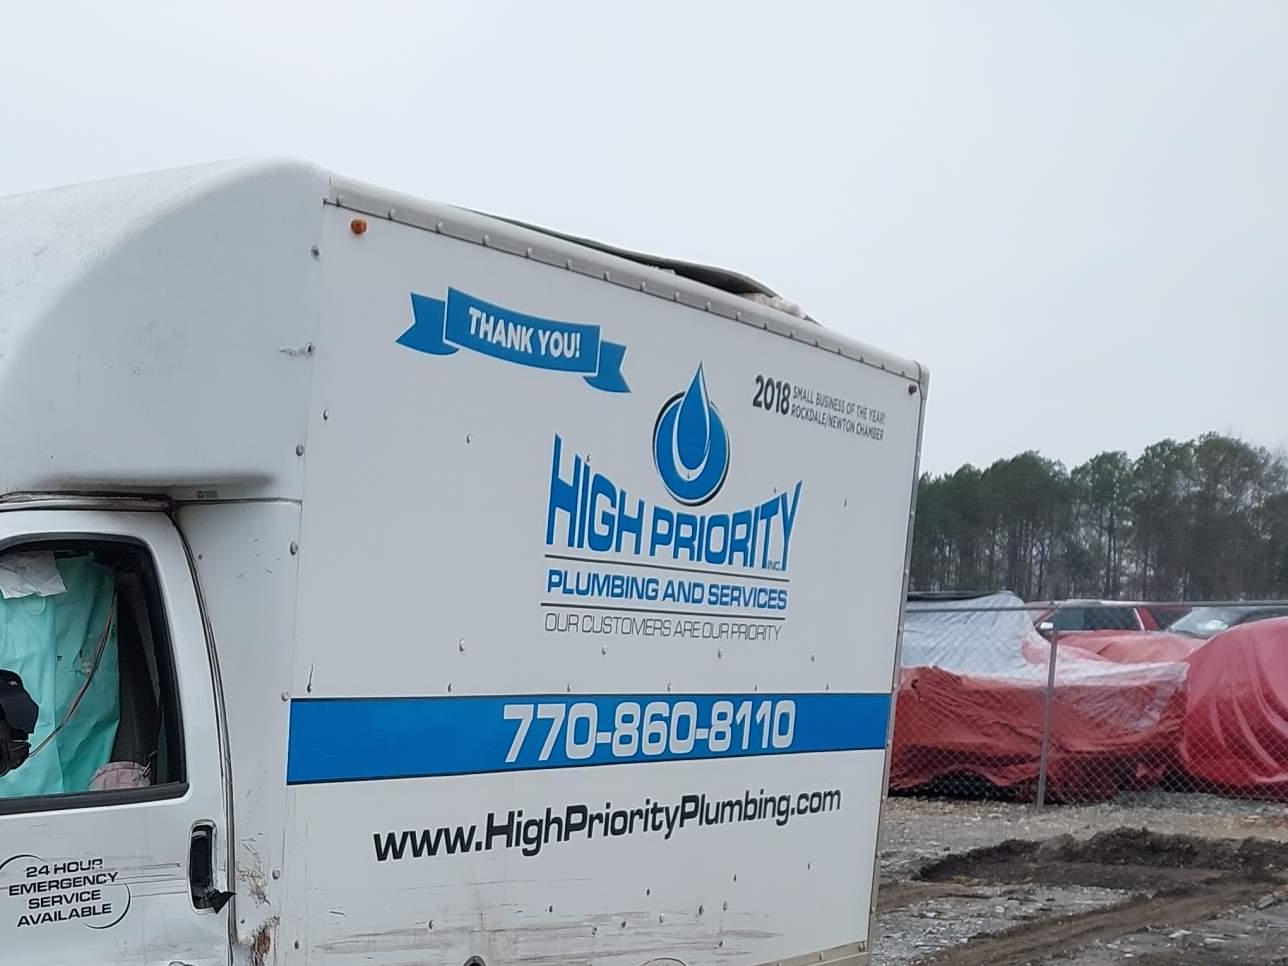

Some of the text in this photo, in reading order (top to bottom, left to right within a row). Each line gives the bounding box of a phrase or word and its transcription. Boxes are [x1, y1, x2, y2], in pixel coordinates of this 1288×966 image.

[468, 306, 581, 358] THANK YOU!
[752, 374, 791, 415] 2018
[793, 385, 814, 404] SMALL
[815, 392, 845, 413] BUSINESS
[846, 402, 856, 415] OF
[857, 405, 868, 420] THE
[856, 422, 884, 440] CHAMBER
[545, 432, 644, 555] HIGH
[649, 480, 803, 572] PRIORITY
[547, 569, 788, 610] PLUMBING AND SERVICES
[545, 612, 782, 640] OUR CUSTOMERS ARE OUR PRIORITY
[503, 699, 796, 763] 770-860-8110
[373, 787, 841, 861] www.HighPriorityPlumbing.com
[8, 871, 119, 896] EMERGENCY
[26, 865, 50, 878] 24
[17, 903, 112, 927] AVAILABLE
[28, 889, 101, 910] SERVICE
